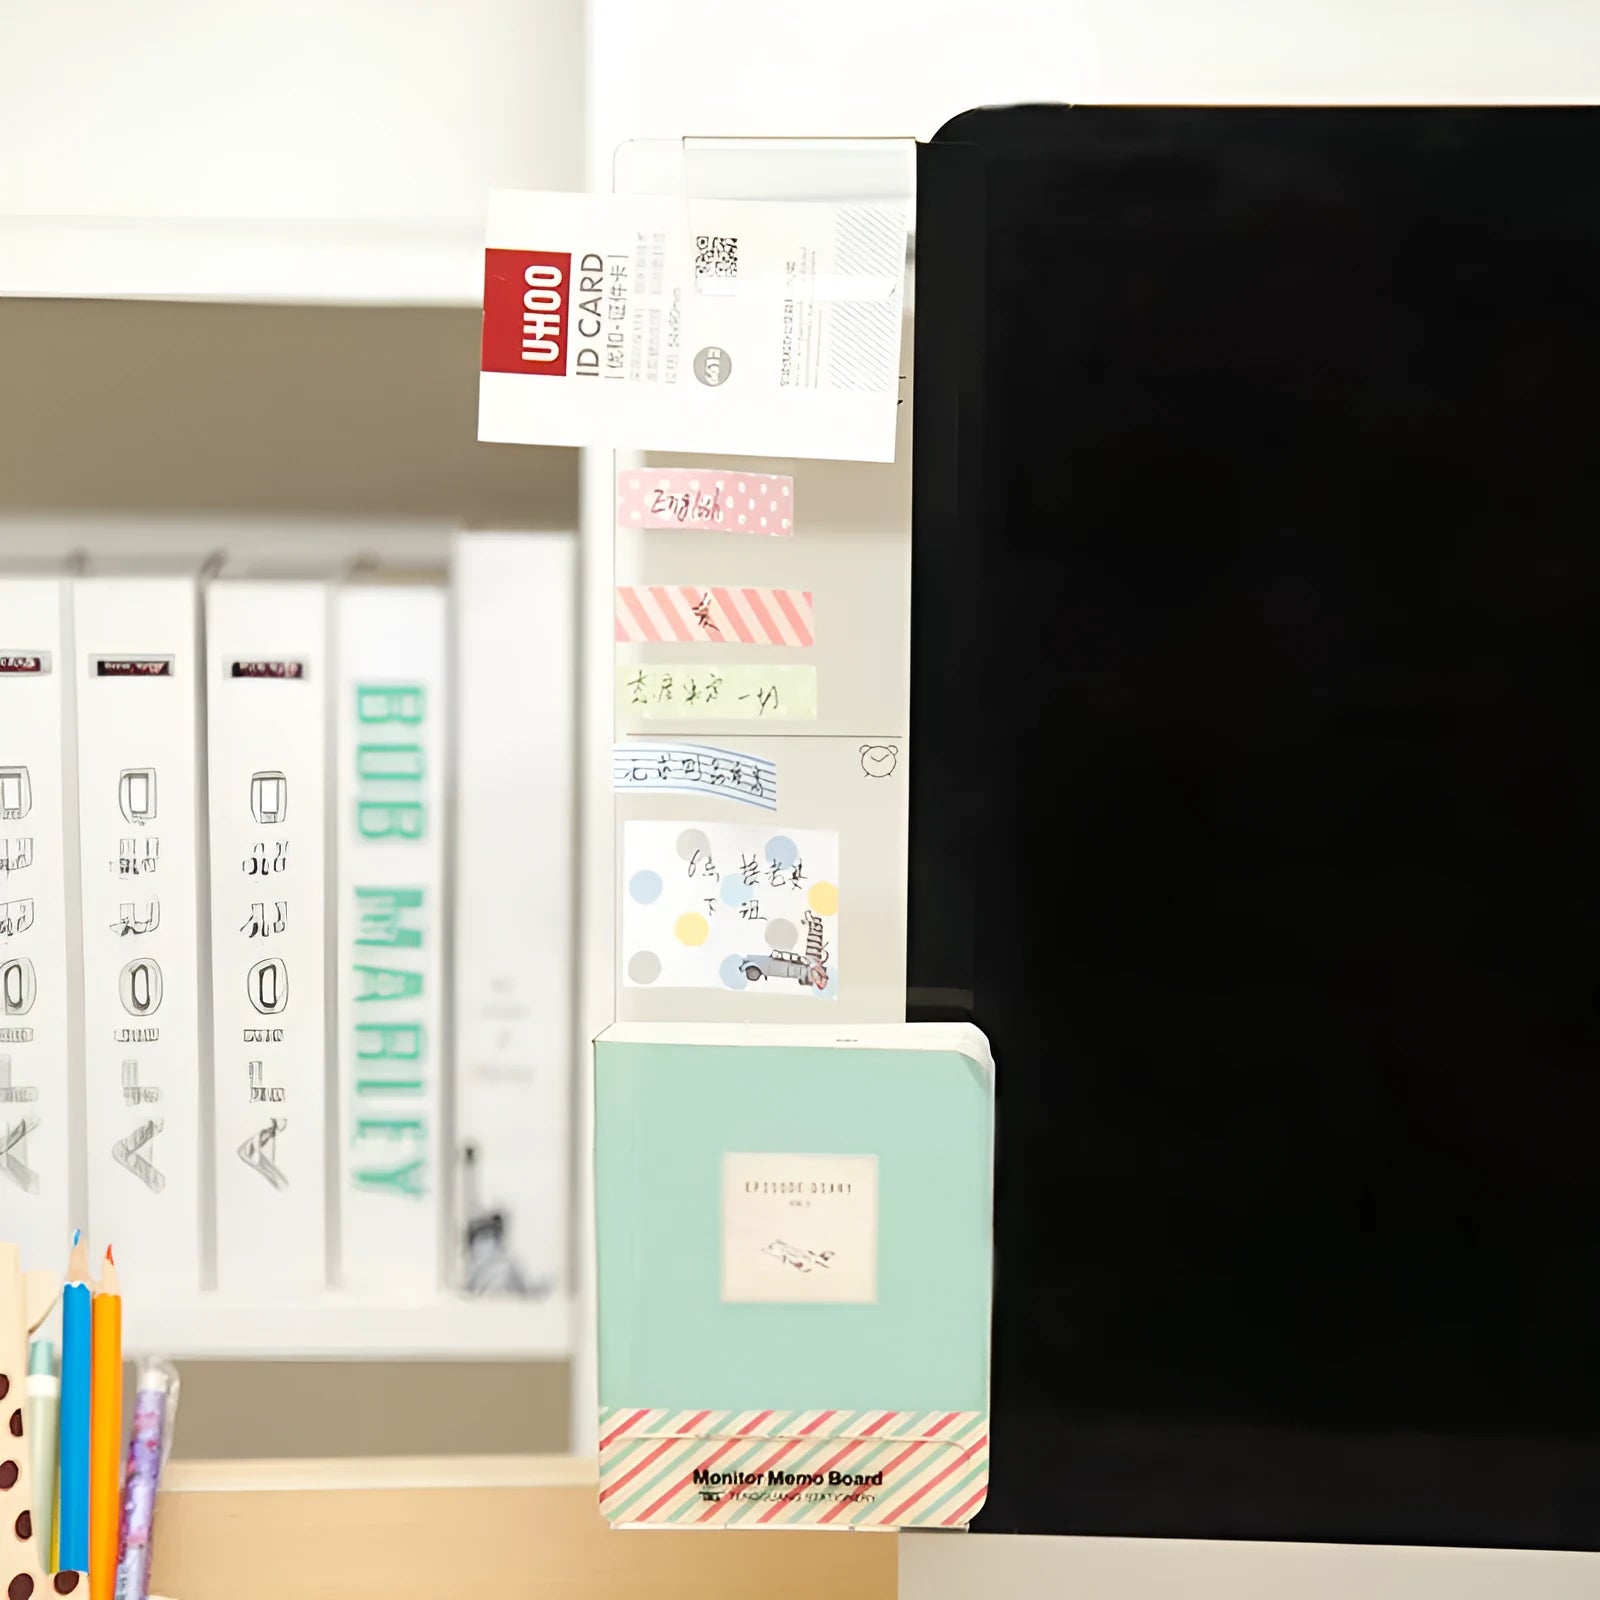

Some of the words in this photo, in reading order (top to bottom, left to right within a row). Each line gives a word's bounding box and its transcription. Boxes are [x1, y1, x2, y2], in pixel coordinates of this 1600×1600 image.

[521, 264, 564, 362] UHOO
[577, 253, 604, 338] CARD
[575, 348, 600, 377] ID
[651, 487, 721, 522] English
[355, 682, 428, 843] BOB
[350, 885, 428, 1200] MARLEY
[692, 1468, 765, 1487] Monitor
[767, 1470, 825, 1487] Memo
[828, 1470, 884, 1487] Board
